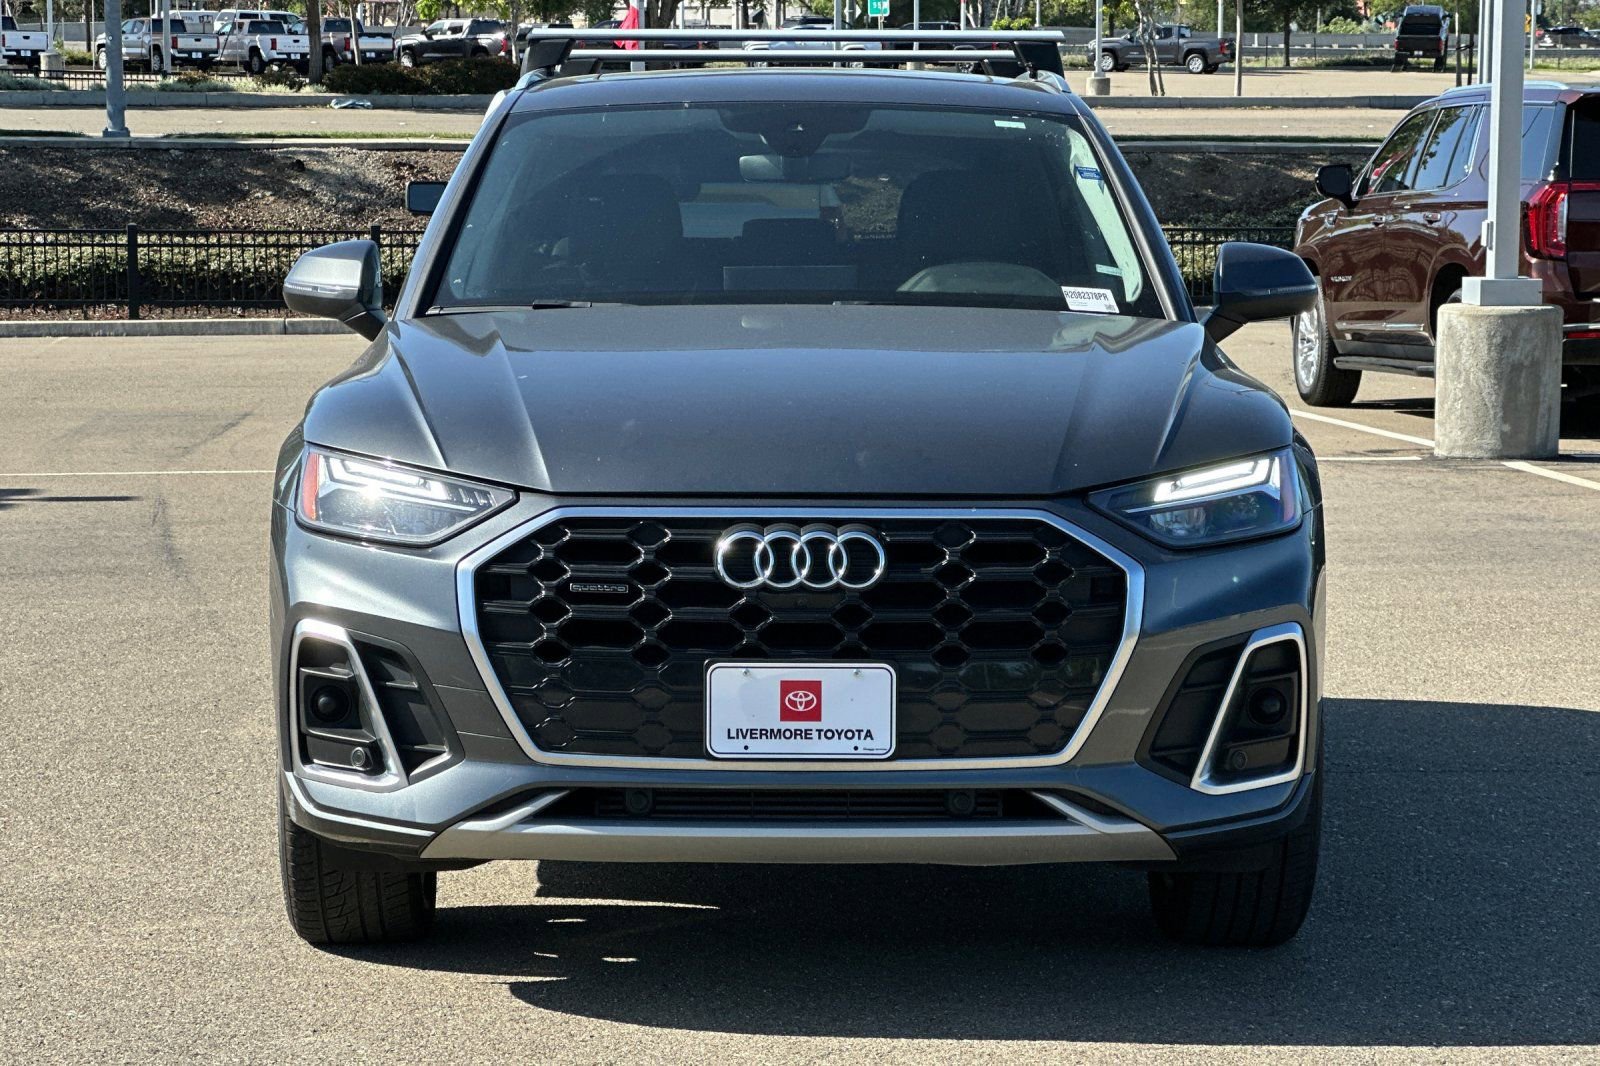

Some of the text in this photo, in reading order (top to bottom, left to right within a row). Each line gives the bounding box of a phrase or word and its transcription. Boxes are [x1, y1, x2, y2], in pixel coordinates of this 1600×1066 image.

[572, 584, 626, 592] quattro
[727, 728, 874, 741] LIVERMORE TOYOTA
